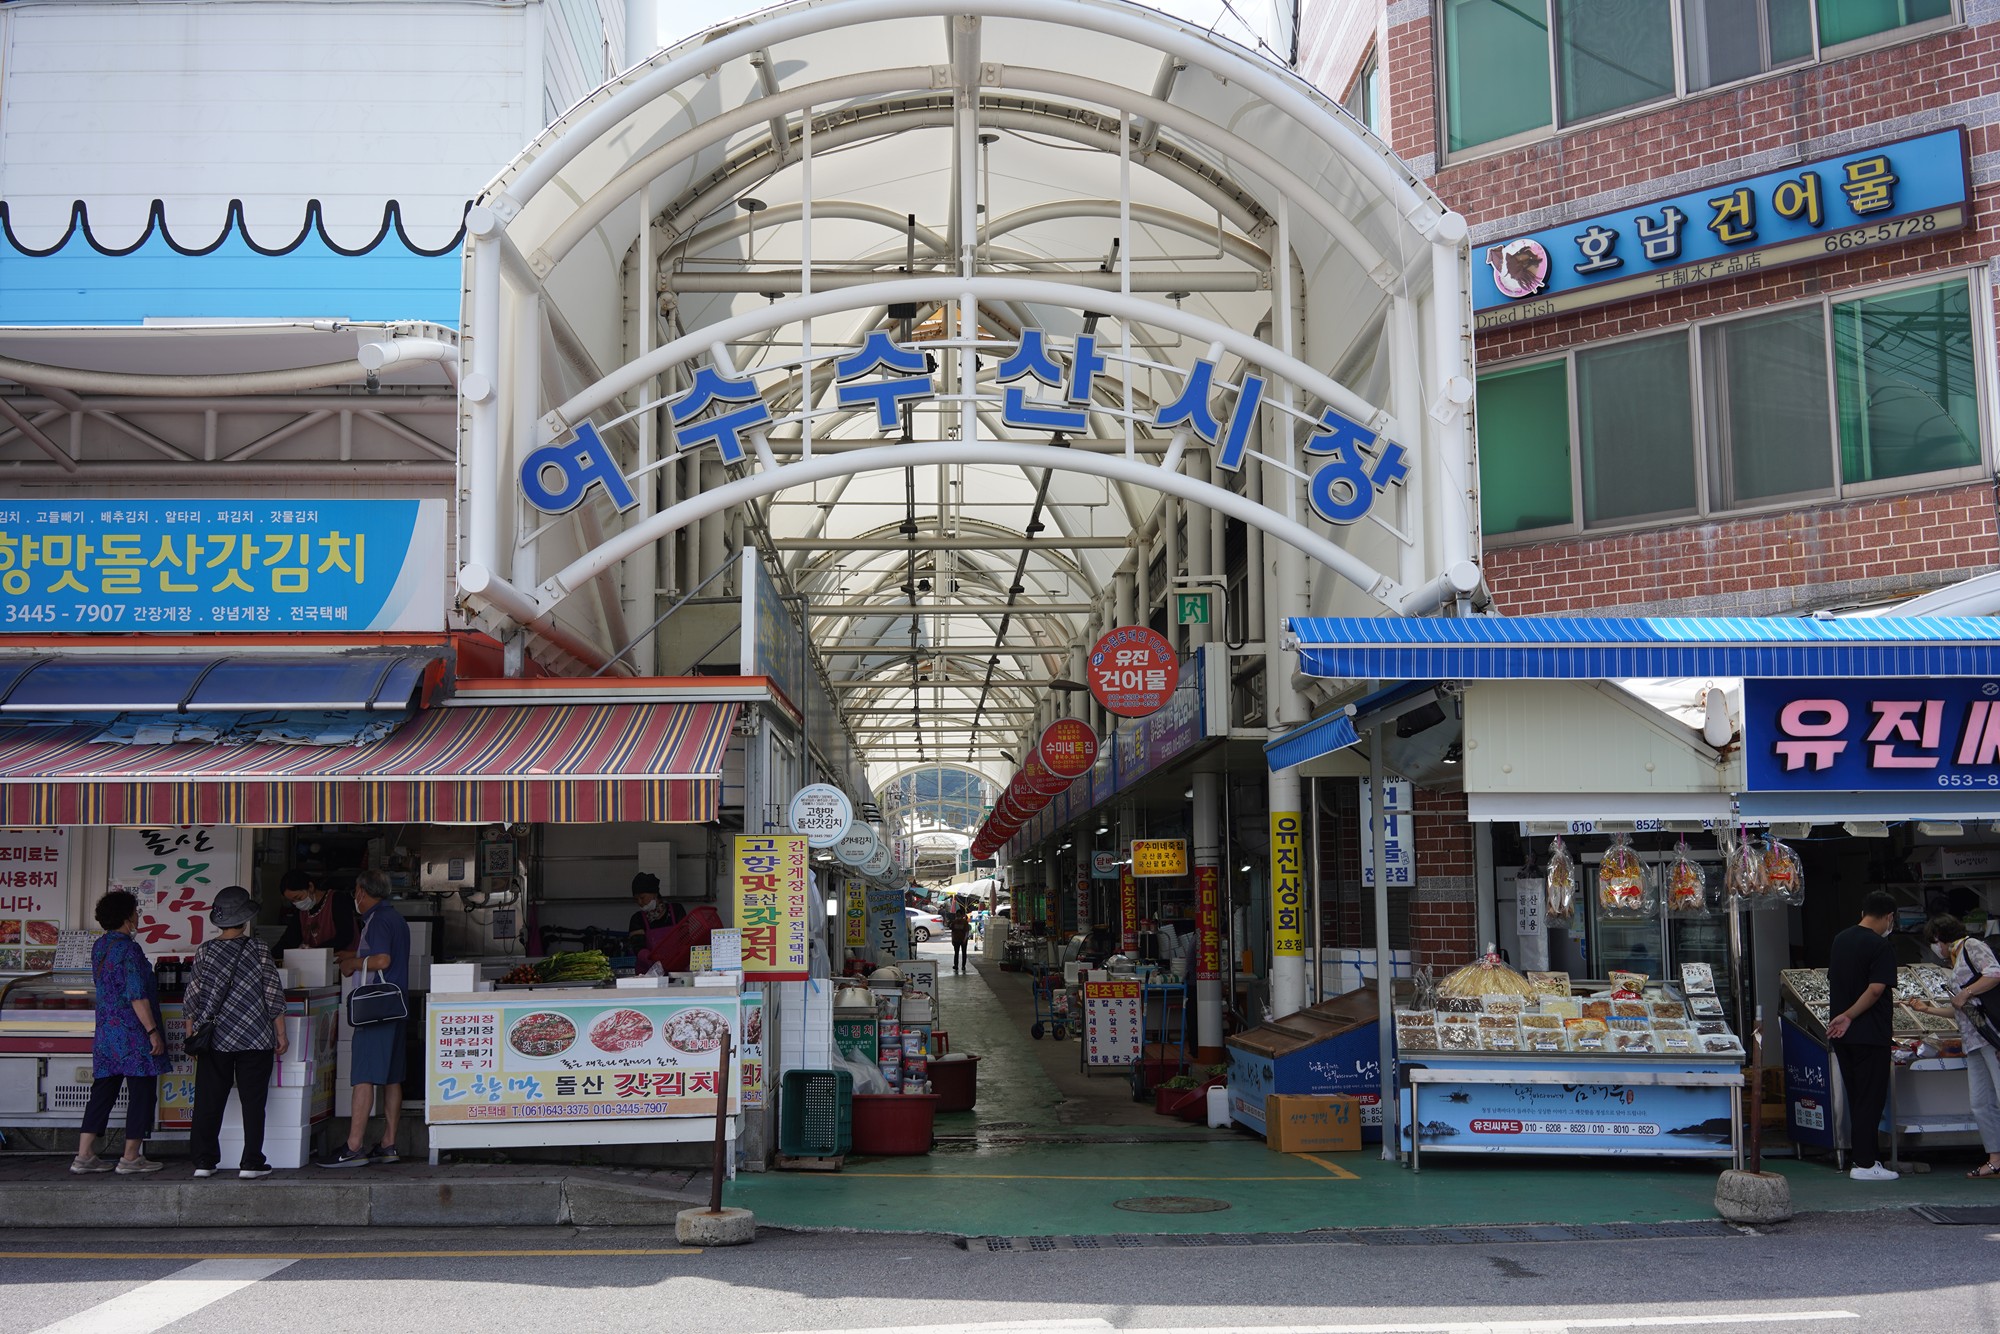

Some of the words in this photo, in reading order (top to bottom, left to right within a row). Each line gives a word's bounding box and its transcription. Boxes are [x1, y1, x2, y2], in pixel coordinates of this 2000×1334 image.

[1824, 214, 1936, 252] 663-5728
[1655, 252, 1762, 290] 干制水产品店
[1475, 309, 1517, 329] Dried
[1522, 300, 1555, 320] Fish
[518, 327, 1412, 525] 여수수산시장
[36, 511, 84, 524] 고들빼기
[101, 511, 149, 524] 배추김치
[165, 511, 200, 523] 알타리
[217, 511, 254, 523] 파김치
[270, 511, 318, 523] 갓물김치
[6, 605, 56, 622] 3445
[75, 605, 126, 622] 7907
[133, 606, 192, 621] 간장게장
[212, 606, 270, 621] 양념게장
[290, 606, 348, 621] 전국택배
[1115, 650, 1150, 667] 유진
[1099, 669, 1168, 692] 건어물
[1045, 741, 1094, 755] 수미네죽집
[806, 807, 834, 819] 고향맛
[798, 818, 842, 830] 돌산갓김치
[1571, 821, 1592, 832] 010
[138, 829, 215, 856] 돌산
[1144, 841, 1185, 851] 수미네죽집
[740, 839, 781, 893] 고향맛
[787, 840, 806, 892] 간장게장
[1275, 817, 1301, 934] 유진상회
[0, 871, 58, 887] 사용하지
[742, 893, 778, 906] 돌산
[787, 894, 805, 918] 전문
[1201, 868, 1219, 971] 수미네죽집
[1528, 895, 1538, 931] 산모용
[740, 906, 782, 966] 갓김치
[788, 920, 805, 965] 전국택배
[879, 920, 898, 957] 콩국
[1277, 938, 1303, 951] 2호점
[440, 1014, 494, 1025] 간장게장
[440, 1026, 494, 1036] 양념게장
[439, 1037, 494, 1047] 배추김치
[616, 1039, 644, 1049] 배추김치
[439, 1048, 493, 1058] 고들빼기
[162, 1080, 195, 1103] 고향
[437, 1073, 543, 1102] 고향맛
[555, 1075, 605, 1096] 돌산
[613, 1070, 720, 1098] 갓김치
[468, 1105, 507, 1118] 전국택배
[593, 1102, 669, 1115] 010-3445-7907
[1473, 1121, 1520, 1132] 유진씨푸드
